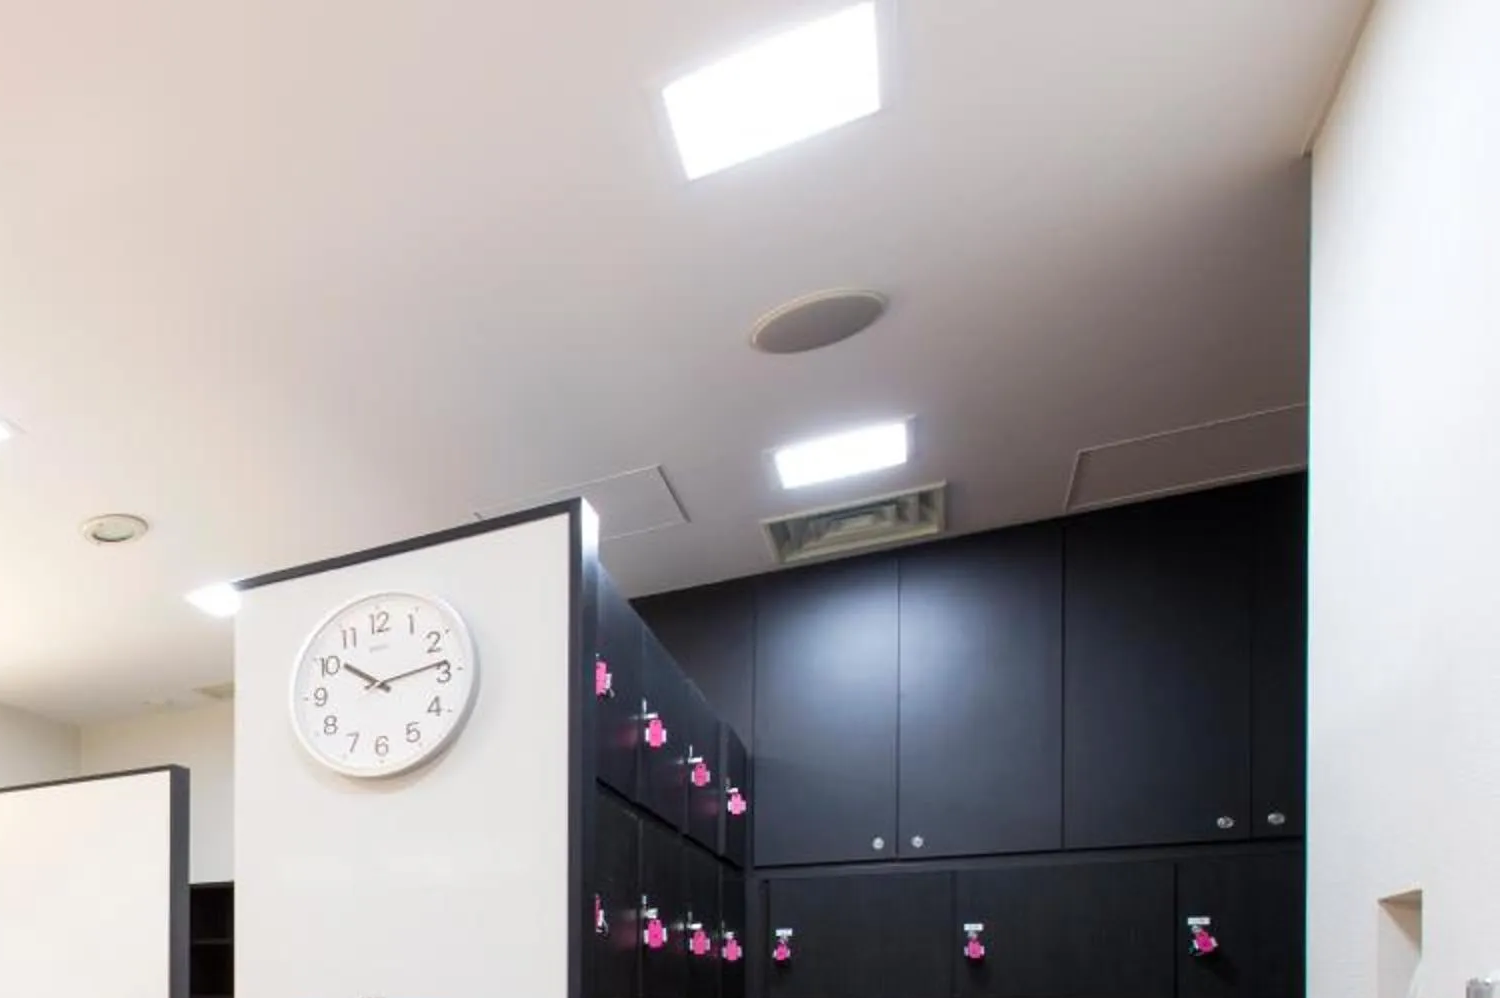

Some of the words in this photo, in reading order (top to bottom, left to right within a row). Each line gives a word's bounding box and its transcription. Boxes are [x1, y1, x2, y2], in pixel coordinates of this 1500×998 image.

[369, 611, 391, 634] 12
[407, 613, 415, 635] 1
[340, 627, 357, 649] 11
[426, 631, 442, 653] 2
[319, 655, 341, 677] 10
[436, 660, 452, 684] 3
[313, 687, 328, 707] 9
[426, 696, 442, 716] 4
[323, 715, 338, 735] 8
[405, 722, 421, 743] 5
[345, 732, 360, 753] 7
[374, 736, 390, 756] 6
